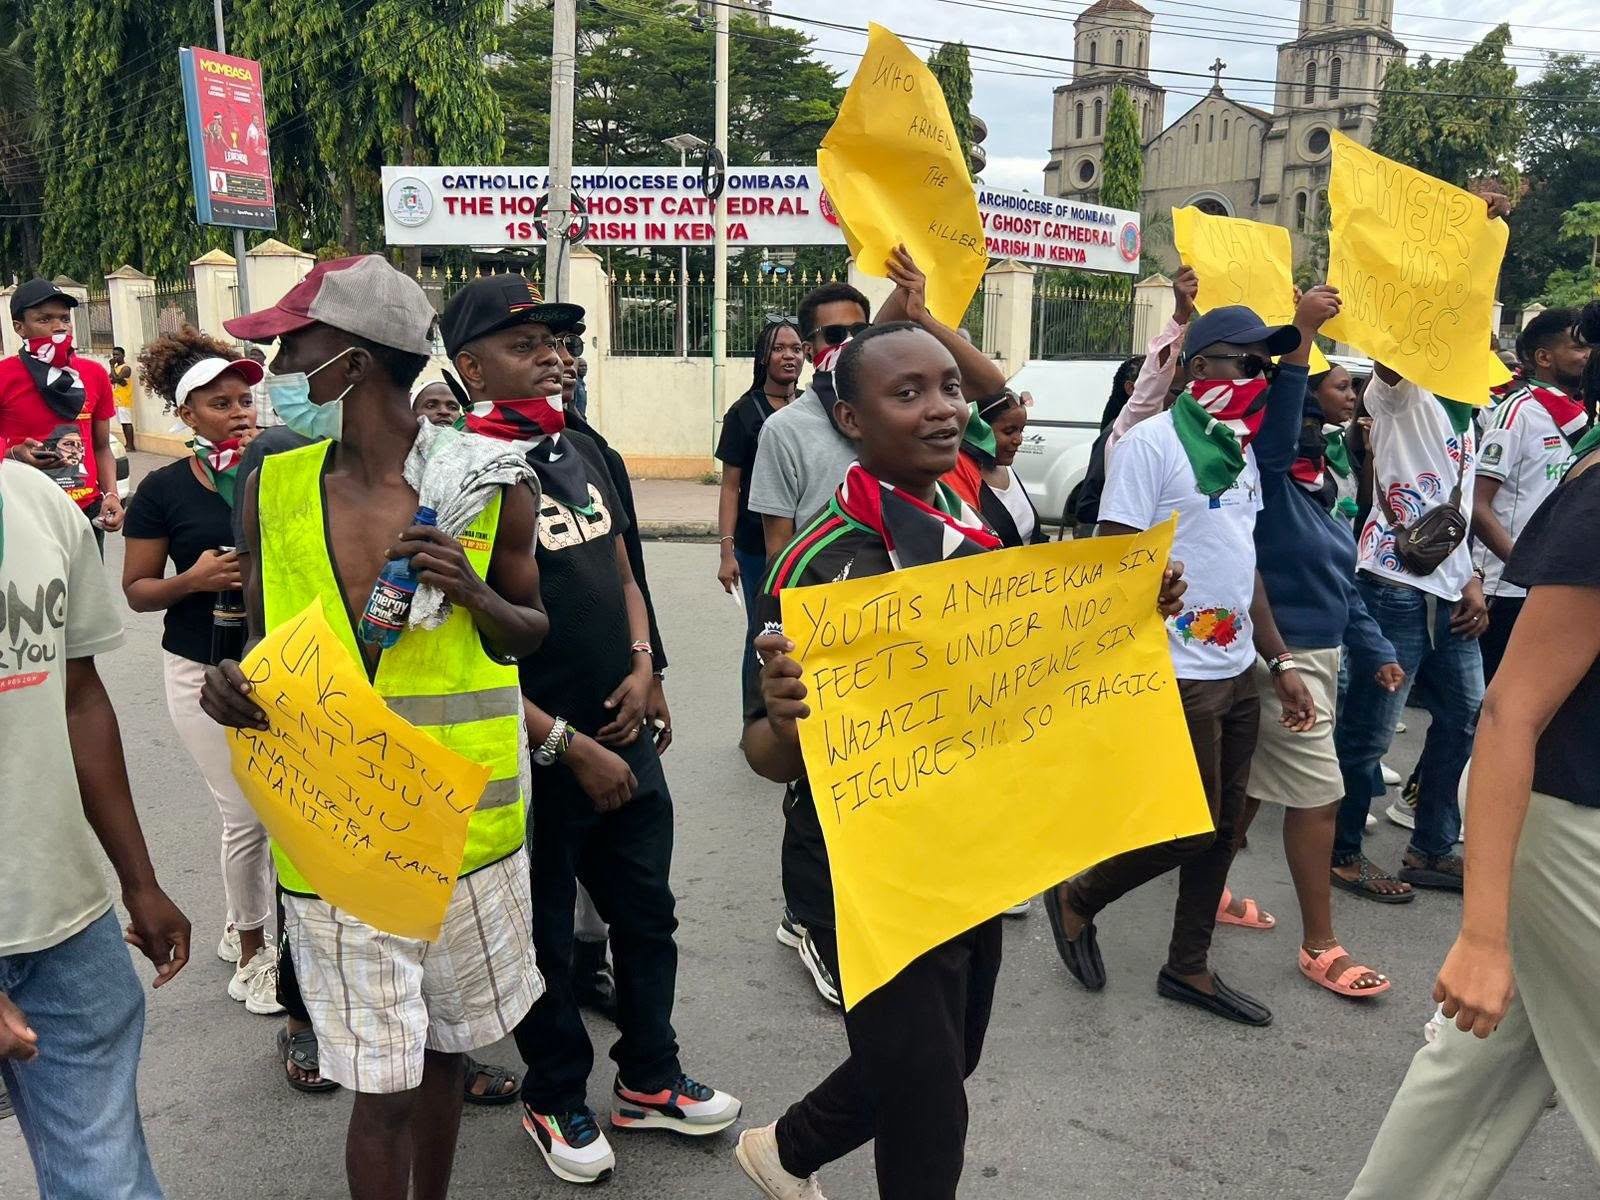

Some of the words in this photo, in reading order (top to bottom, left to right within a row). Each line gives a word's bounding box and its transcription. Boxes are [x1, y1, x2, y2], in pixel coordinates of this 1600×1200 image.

[199, 58, 254, 82] MOMBASA
[871, 56, 915, 92] WHO
[907, 115, 953, 151] ARMED
[442, 174, 539, 190] CATHOLIC
[712, 174, 810, 190] OMBASA
[924, 164, 949, 188] THE
[443, 196, 494, 216] THE
[978, 191, 1053, 216] ARCHDIOCESE
[1055, 204, 1069, 218] OF
[1070, 206, 1117, 227] MOMBASA
[644, 222, 667, 240] IN
[992, 213, 1042, 237] GHOST
[1044, 221, 1116, 247] CATHEDRAL
[985, 236, 1030, 257] PARISH
[1034, 243, 1046, 258] IN
[1049, 244, 1087, 263] KENYA
[371, 585, 409, 616] Energy
[801, 591, 924, 662] YOUTHS
[940, 562, 1104, 620] ANAPELEKWA
[1116, 547, 1159, 575] SIX
[9, 637, 57, 671] YOU
[812, 640, 930, 711] FEETS
[945, 611, 1043, 668] UNDER
[1062, 596, 1113, 634] NDO
[823, 687, 950, 768] WAZAZI
[1095, 621, 1138, 657] SIX
[248, 656, 347, 759] RENT
[357, 754, 424, 810] JUU
[280, 616, 389, 762] UNGA
[396, 741, 475, 816] JUU
[830, 719, 1010, 825] FIGURES!!!
[1020, 703, 1053, 743] SO
[335, 774, 412, 833] JUU
